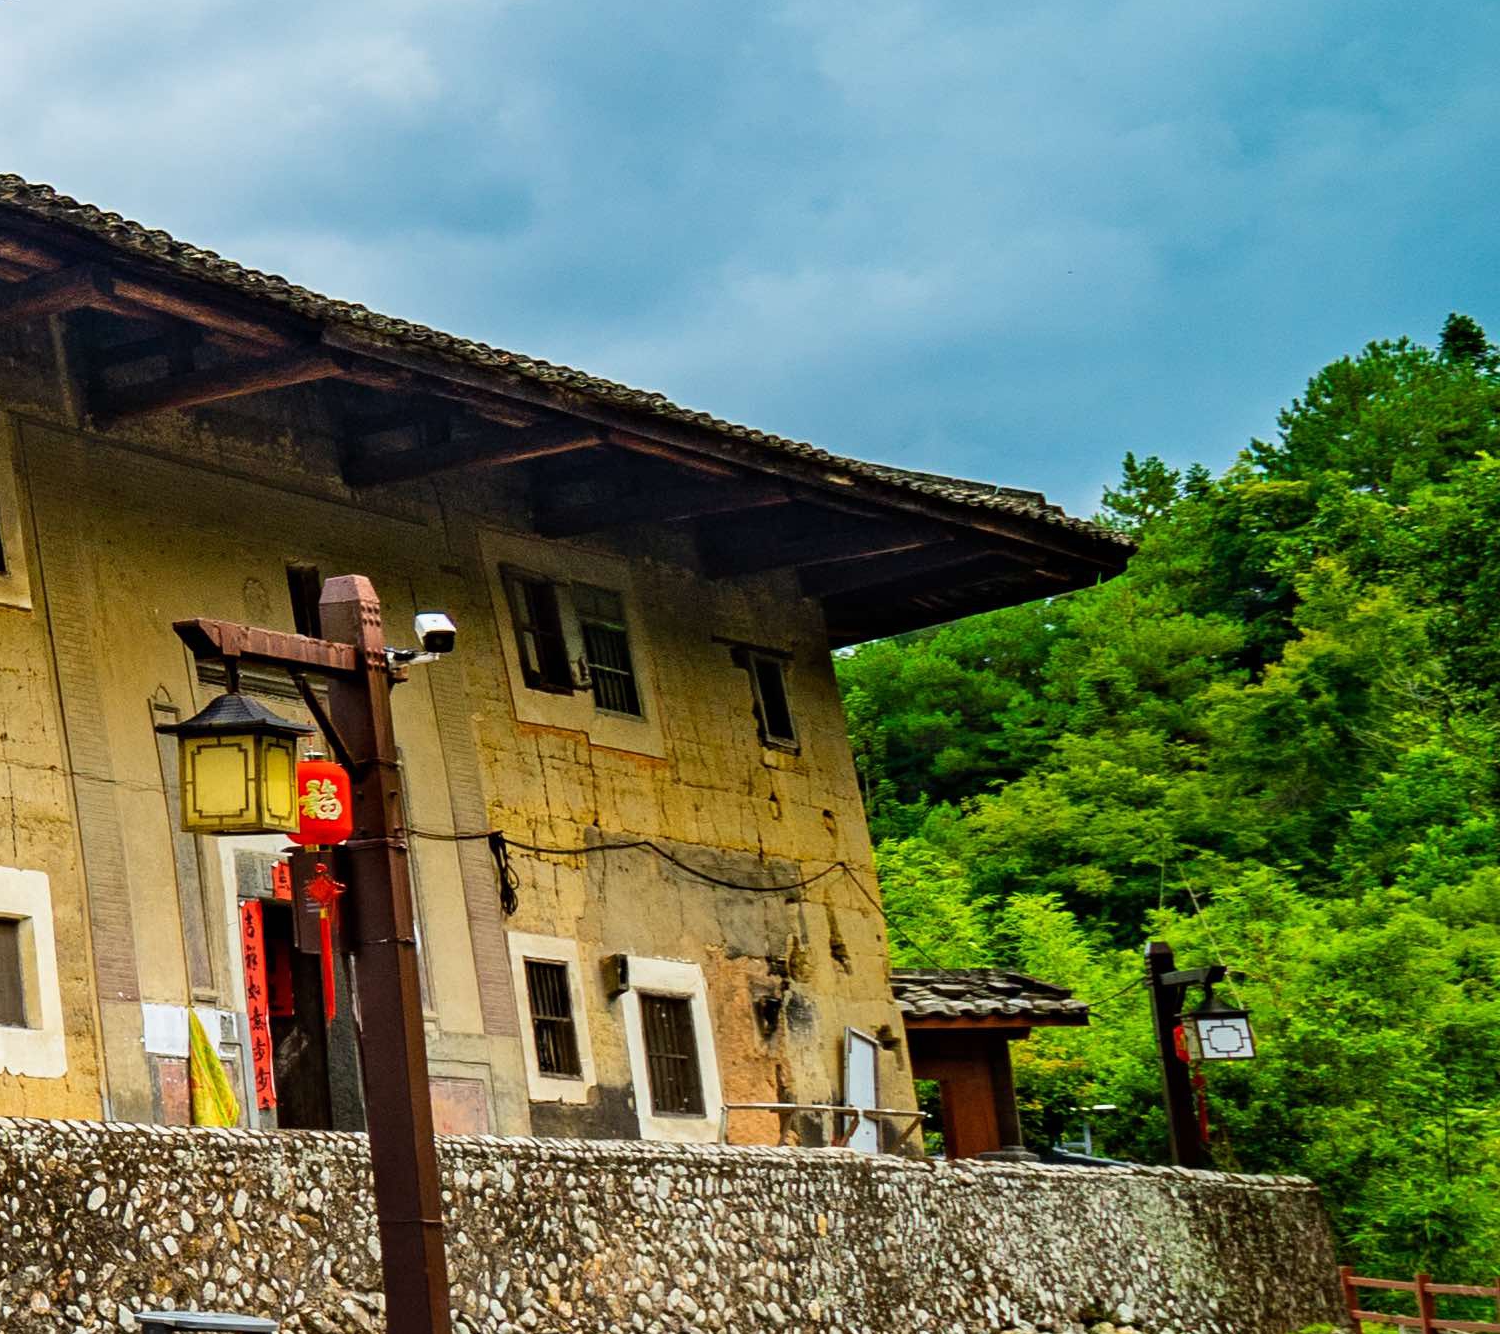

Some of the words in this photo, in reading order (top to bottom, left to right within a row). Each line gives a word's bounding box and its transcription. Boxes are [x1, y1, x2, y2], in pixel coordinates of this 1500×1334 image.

[299, 778, 343, 820] 福
[243, 907, 271, 1110] 吉祥如意步步
